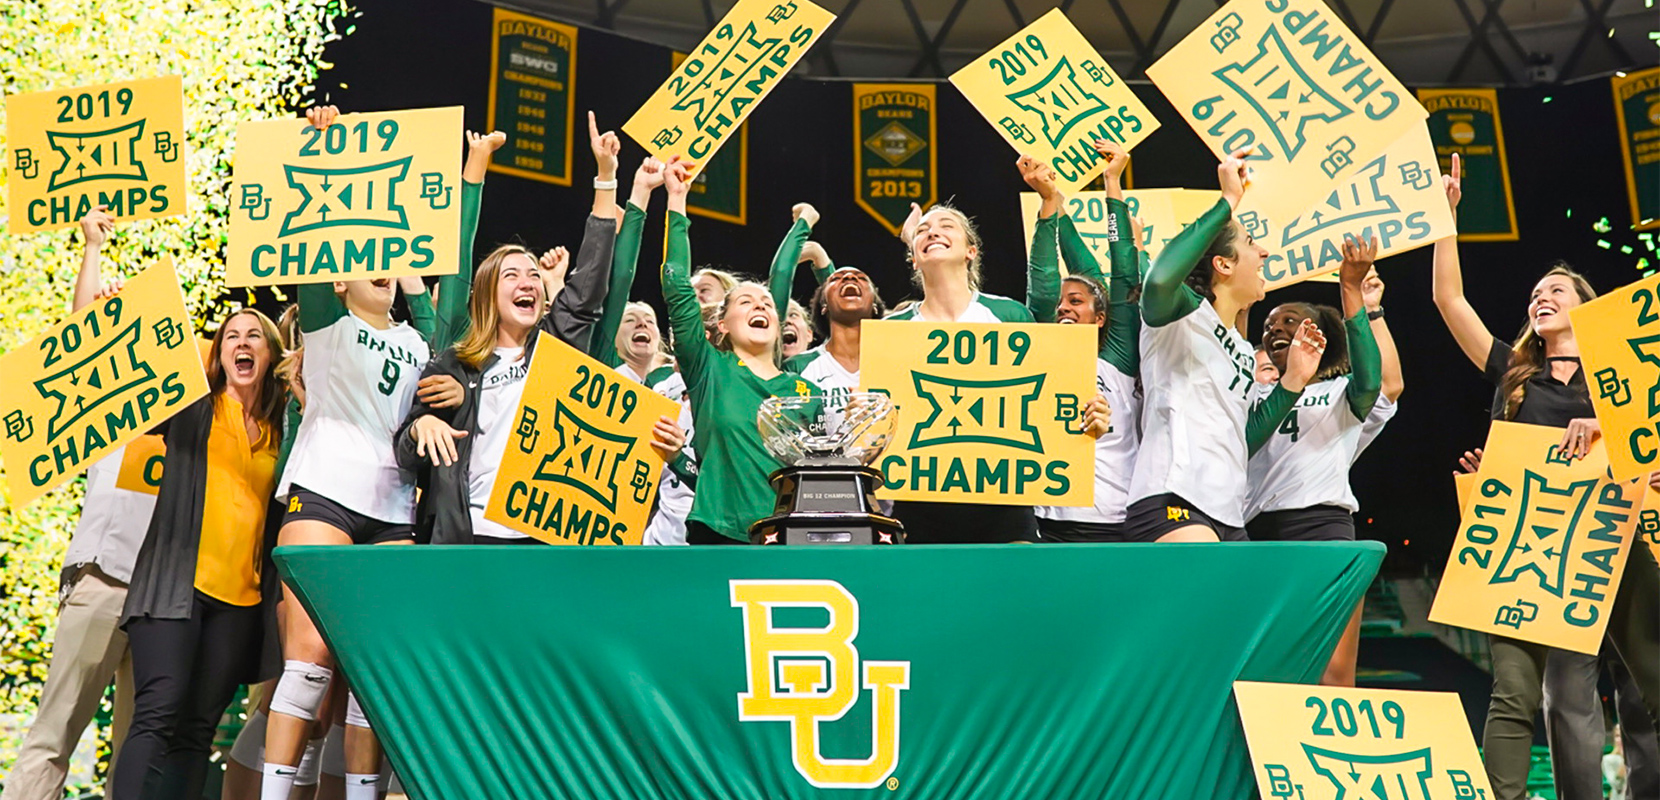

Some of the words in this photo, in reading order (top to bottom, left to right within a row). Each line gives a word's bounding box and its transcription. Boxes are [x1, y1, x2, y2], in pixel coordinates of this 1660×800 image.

[765, 0, 798, 25] BU
[501, 22, 569, 51] BAYLOR
[1209, 11, 1243, 54] BU
[668, 23, 733, 96] 2019
[989, 34, 1048, 86] 2019
[1080, 59, 1114, 87] BU
[57, 88, 133, 123] 2019
[687, 24, 813, 159] CHAMPS
[861, 93, 929, 111] BAYLOR
[154, 131, 179, 162] BU
[299, 119, 399, 157] 2019
[651, 125, 682, 149] BU
[998, 116, 1036, 145] BU
[14, 148, 39, 180] BU
[1320, 135, 1356, 180] BU
[1398, 160, 1432, 191] BU
[28, 185, 169, 226] CHAMPS
[239, 184, 272, 221] BU
[420, 172, 453, 210] BU
[870, 181, 922, 197] 2013
[1069, 196, 1140, 222] 209
[1238, 210, 1269, 241] BU
[251, 235, 435, 277] CHAMPS
[1263, 210, 1432, 282] CHAMPS
[40, 297, 123, 368] 2019
[152, 317, 184, 349] BU
[927, 329, 1031, 366] 2019
[378, 358, 400, 396] 9
[569, 365, 637, 424] 2019
[796, 380, 811, 403] BU
[1594, 367, 1632, 407] BU
[3, 409, 33, 442] BU
[29, 372, 185, 487] CHAMPS
[516, 405, 540, 454] BU
[1278, 409, 1300, 442] 4
[629, 459, 652, 504] BU
[880, 455, 1071, 496] CHAMPS
[1459, 478, 1513, 569] 2019
[1563, 465, 1639, 628] CHAMP
[1494, 598, 1540, 630] BU
[729, 579, 910, 789] BU
[1305, 696, 1405, 739] 2019
